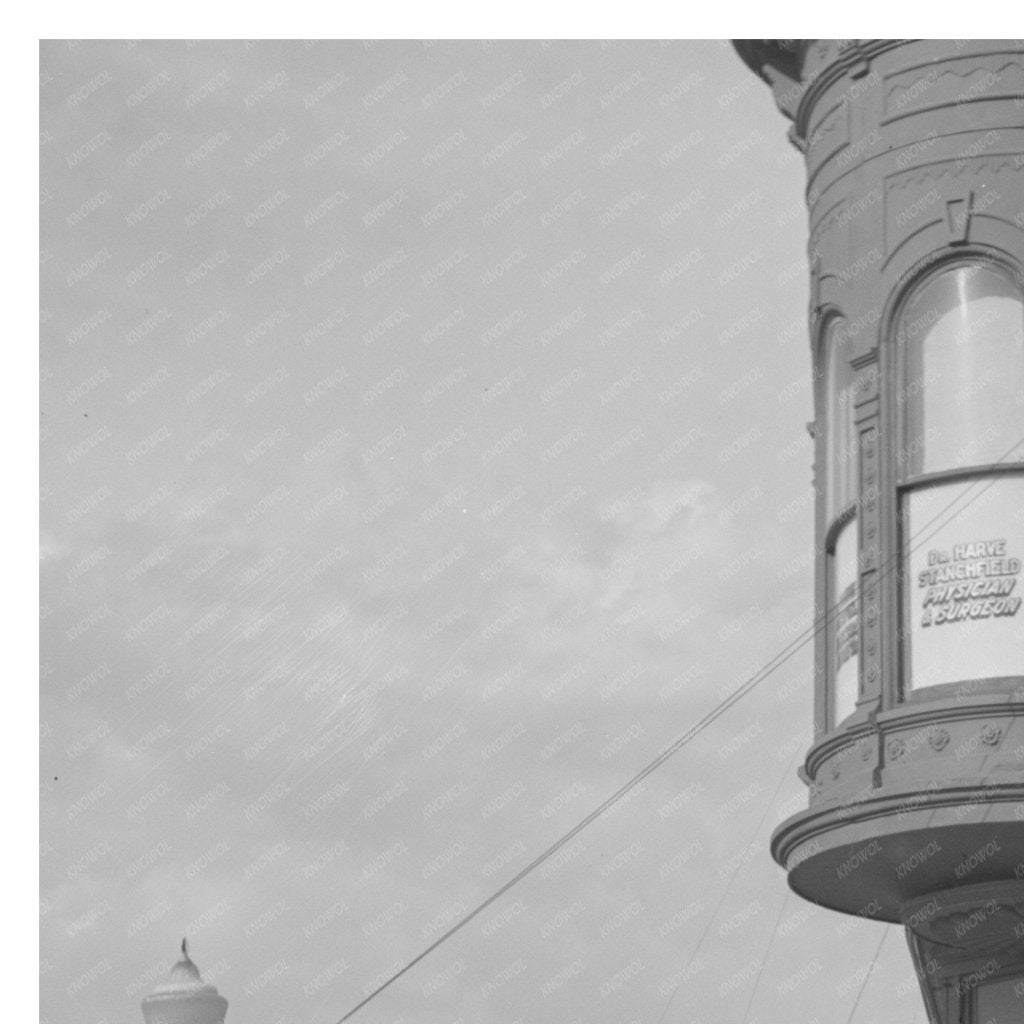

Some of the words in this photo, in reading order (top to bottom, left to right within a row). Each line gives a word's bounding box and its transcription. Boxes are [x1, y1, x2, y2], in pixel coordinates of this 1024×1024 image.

[953, 540, 1007, 562] HARVE
[918, 558, 1021, 588] STANCHFIELD
[922, 579, 1016, 609] PHYSICIAN
[935, 598, 1022, 627] SURGEON
